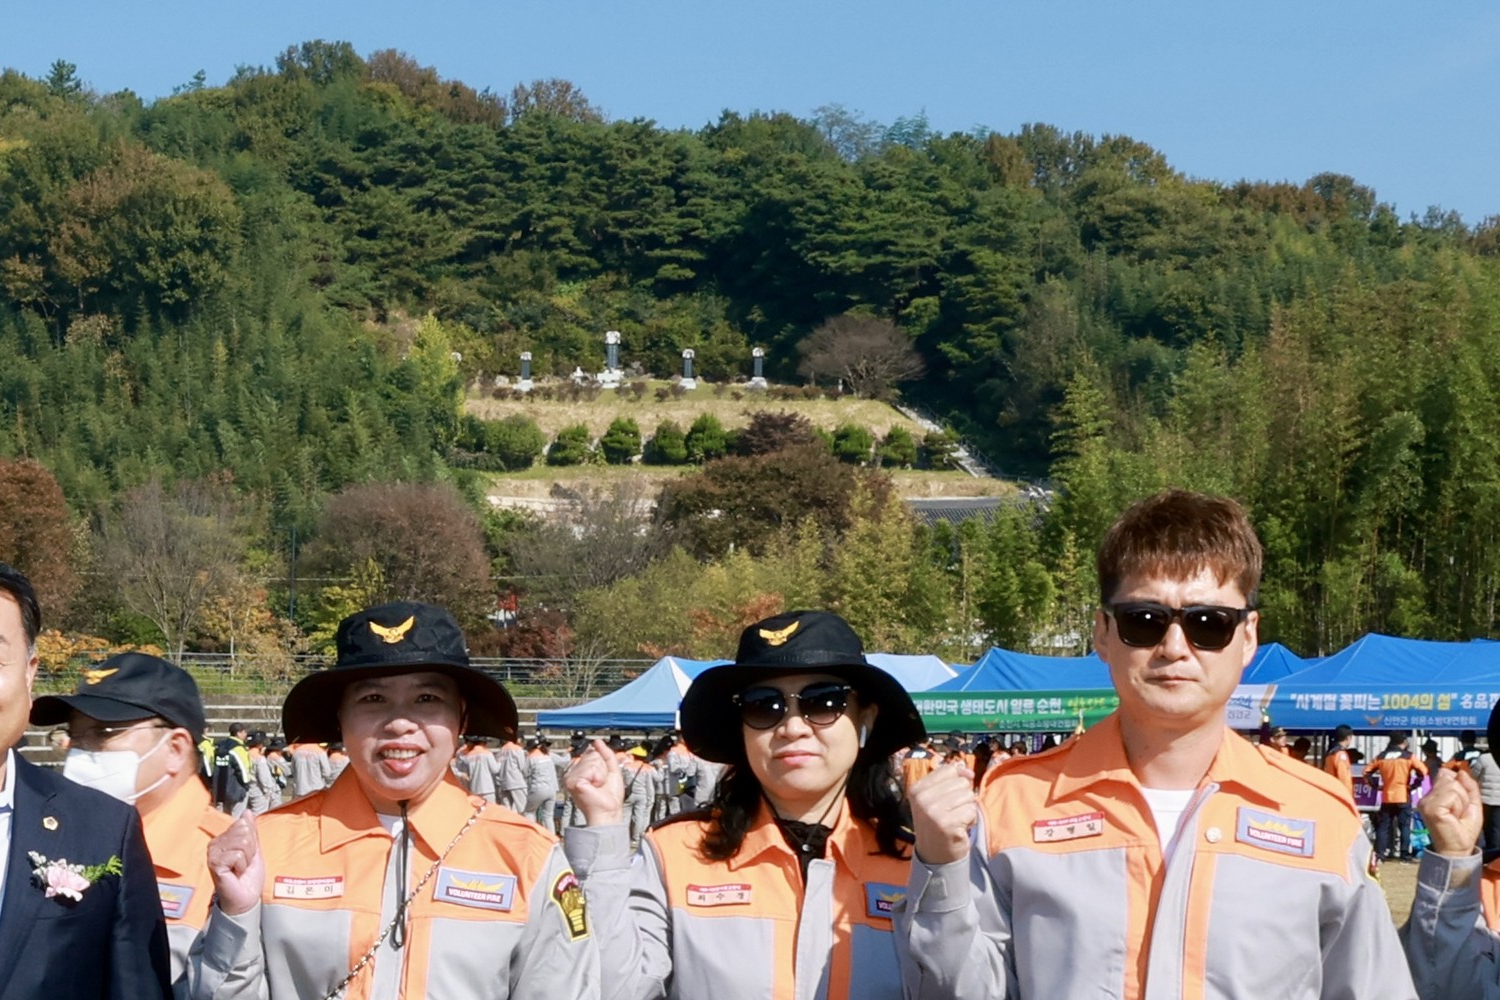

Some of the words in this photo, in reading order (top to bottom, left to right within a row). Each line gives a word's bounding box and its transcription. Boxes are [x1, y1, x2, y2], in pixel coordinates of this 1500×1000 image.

[960, 699, 1008, 715] 생태도시
[1010, 698, 1035, 714] 일류
[1249, 828, 1286, 844] VOLUNTEER
[1287, 837, 1303, 847] FIRE
[448, 887, 486, 901] VOLUNTEER
[486, 893, 502, 903] FIRE
